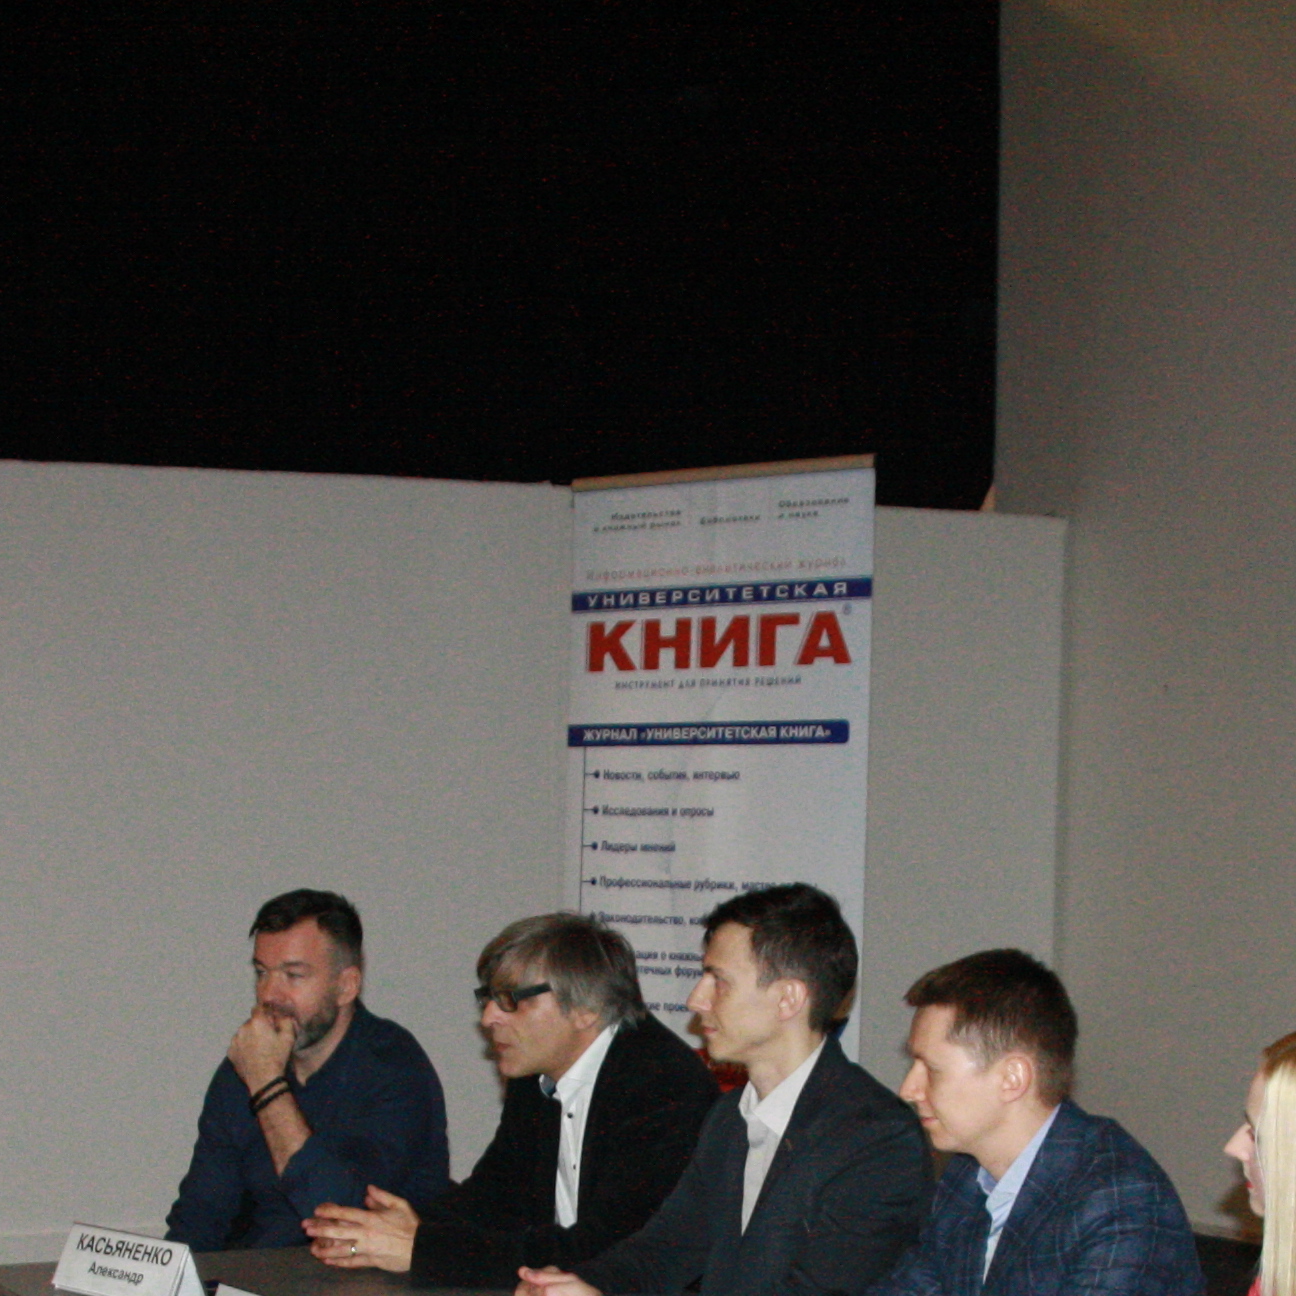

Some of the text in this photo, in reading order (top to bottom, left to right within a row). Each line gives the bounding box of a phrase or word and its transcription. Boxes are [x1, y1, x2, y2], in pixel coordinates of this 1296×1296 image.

[587, 582, 848, 608] УНИВЕРСИТЕТСКАЯ
[586, 610, 852, 673] КНИГА
[614, 679, 675, 690] ИНСТРУМЕНТ
[754, 675, 802, 687] РЕШЕНИЙ
[583, 724, 832, 741] ЖУРНАЛ «УНИВЕРСИТЕТСКАЯ КНИГА»
[603, 769, 645, 783] Новости,
[692, 770, 741, 783] интервью
[601, 804, 670, 818] Исследования
[679, 807, 715, 820] опросы
[600, 839, 638, 854] Лидеры
[599, 874, 692, 890] Профессиональные
[76, 1232, 173, 1267] КАСЬЯНЕНКО
[88, 1261, 144, 1287] Александр
